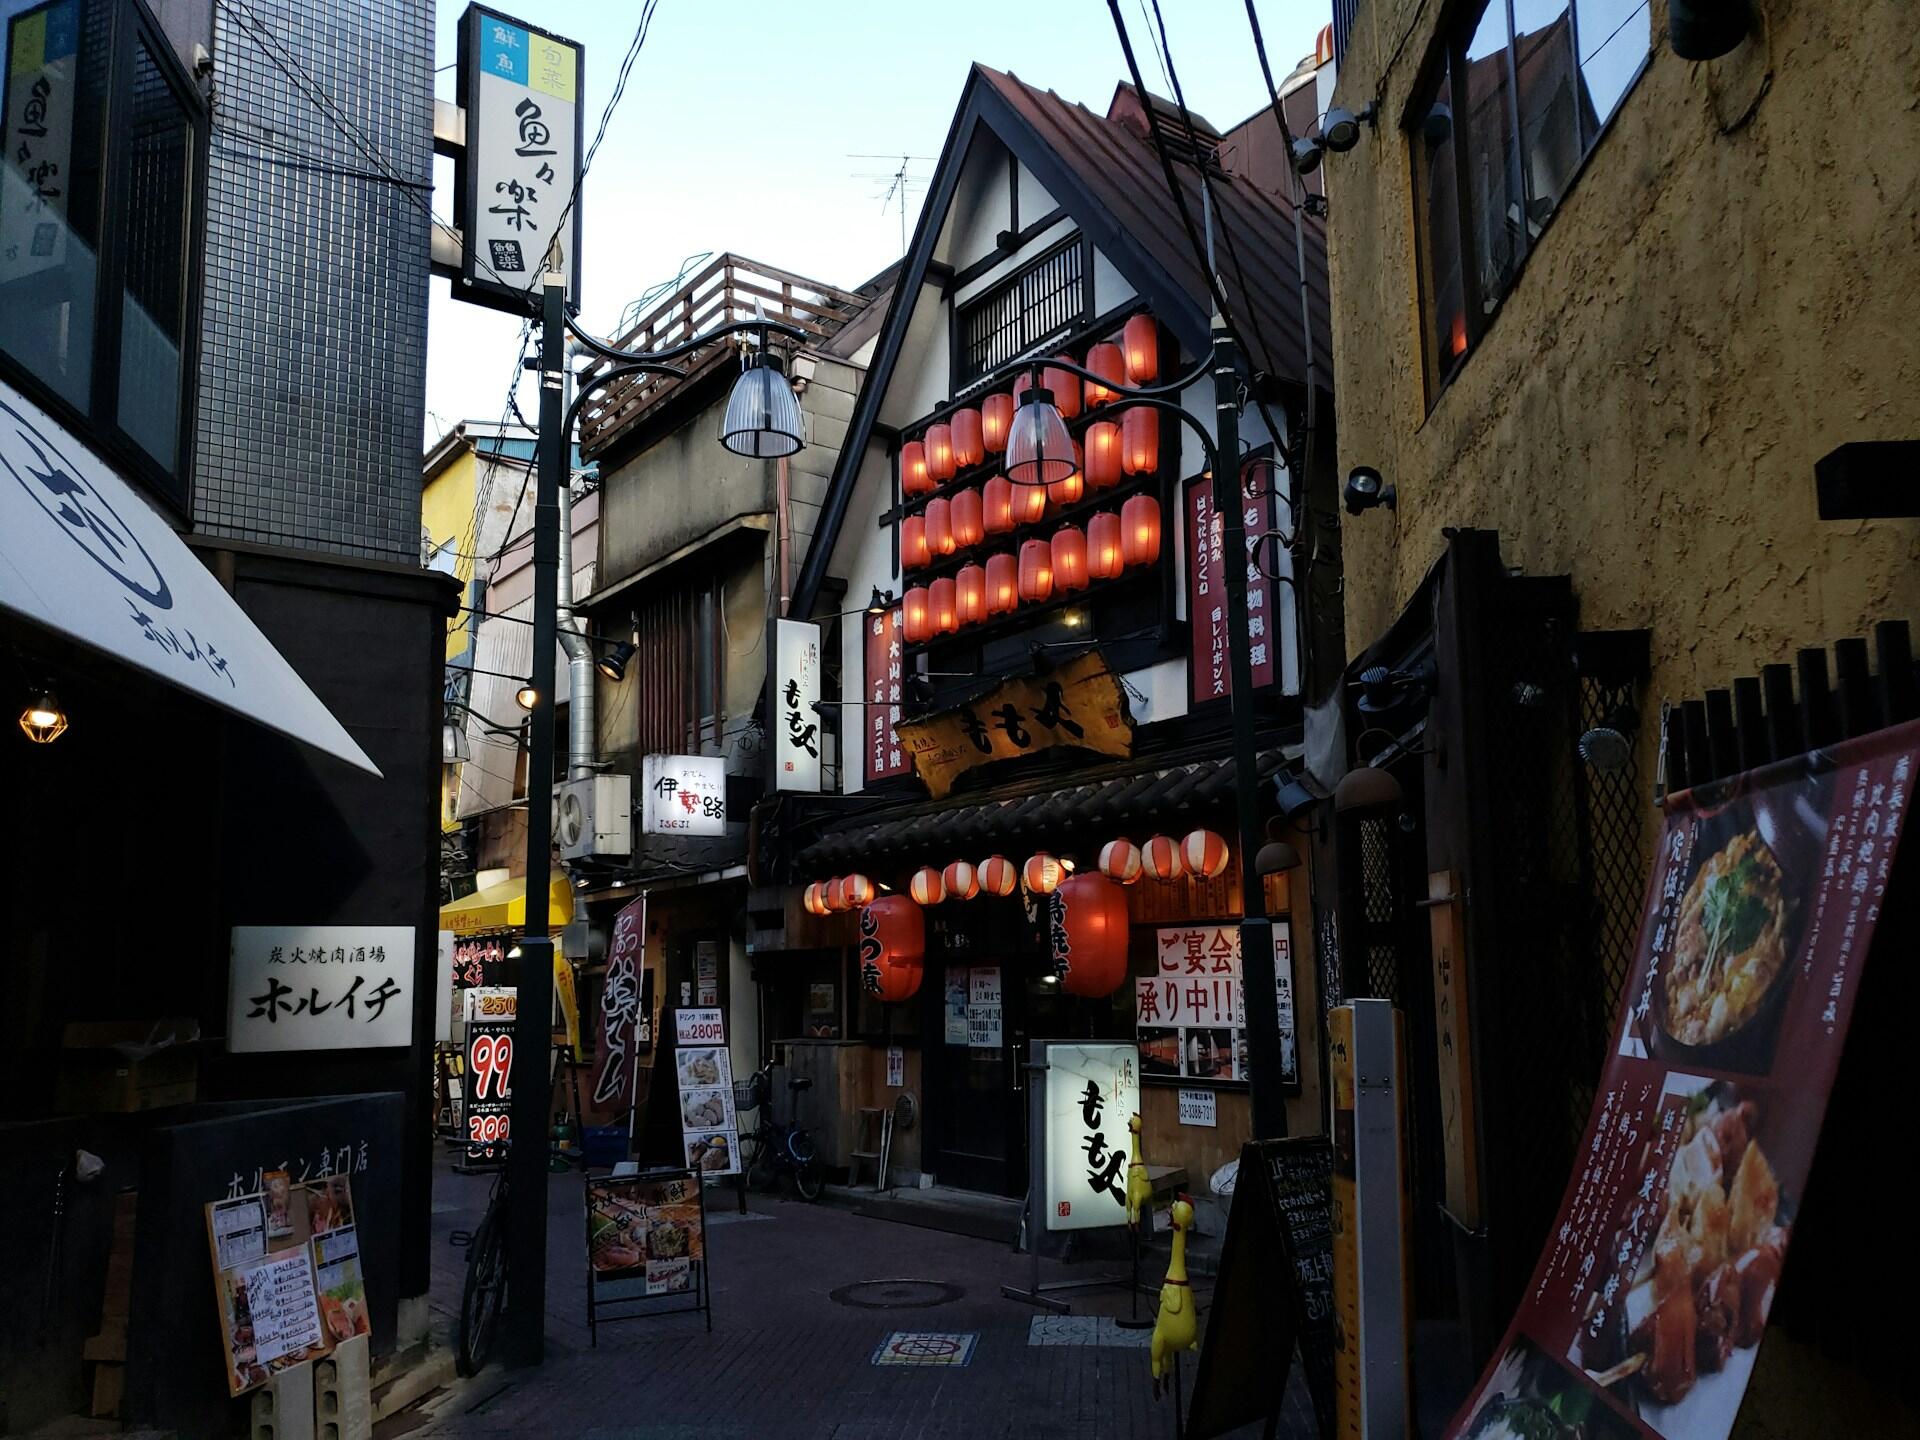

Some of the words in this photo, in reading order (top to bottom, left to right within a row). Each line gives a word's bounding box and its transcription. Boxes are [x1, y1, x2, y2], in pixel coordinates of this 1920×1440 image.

[492, 24, 521, 75] 鮮魚
[488, 97, 558, 231] 魚々楽
[123, 596, 236, 688] ホルイチ
[654, 776, 725, 819] 伊勢路
[659, 820, 690, 828] ISEJI
[268, 946, 387, 965] 炭火焼肉酒場
[1161, 928, 1233, 975] ご宴会
[246, 975, 402, 1024] ホルイチ
[470, 1034, 514, 1100] 99
[1588, 1166, 1659, 1338] 炭火串焼き
